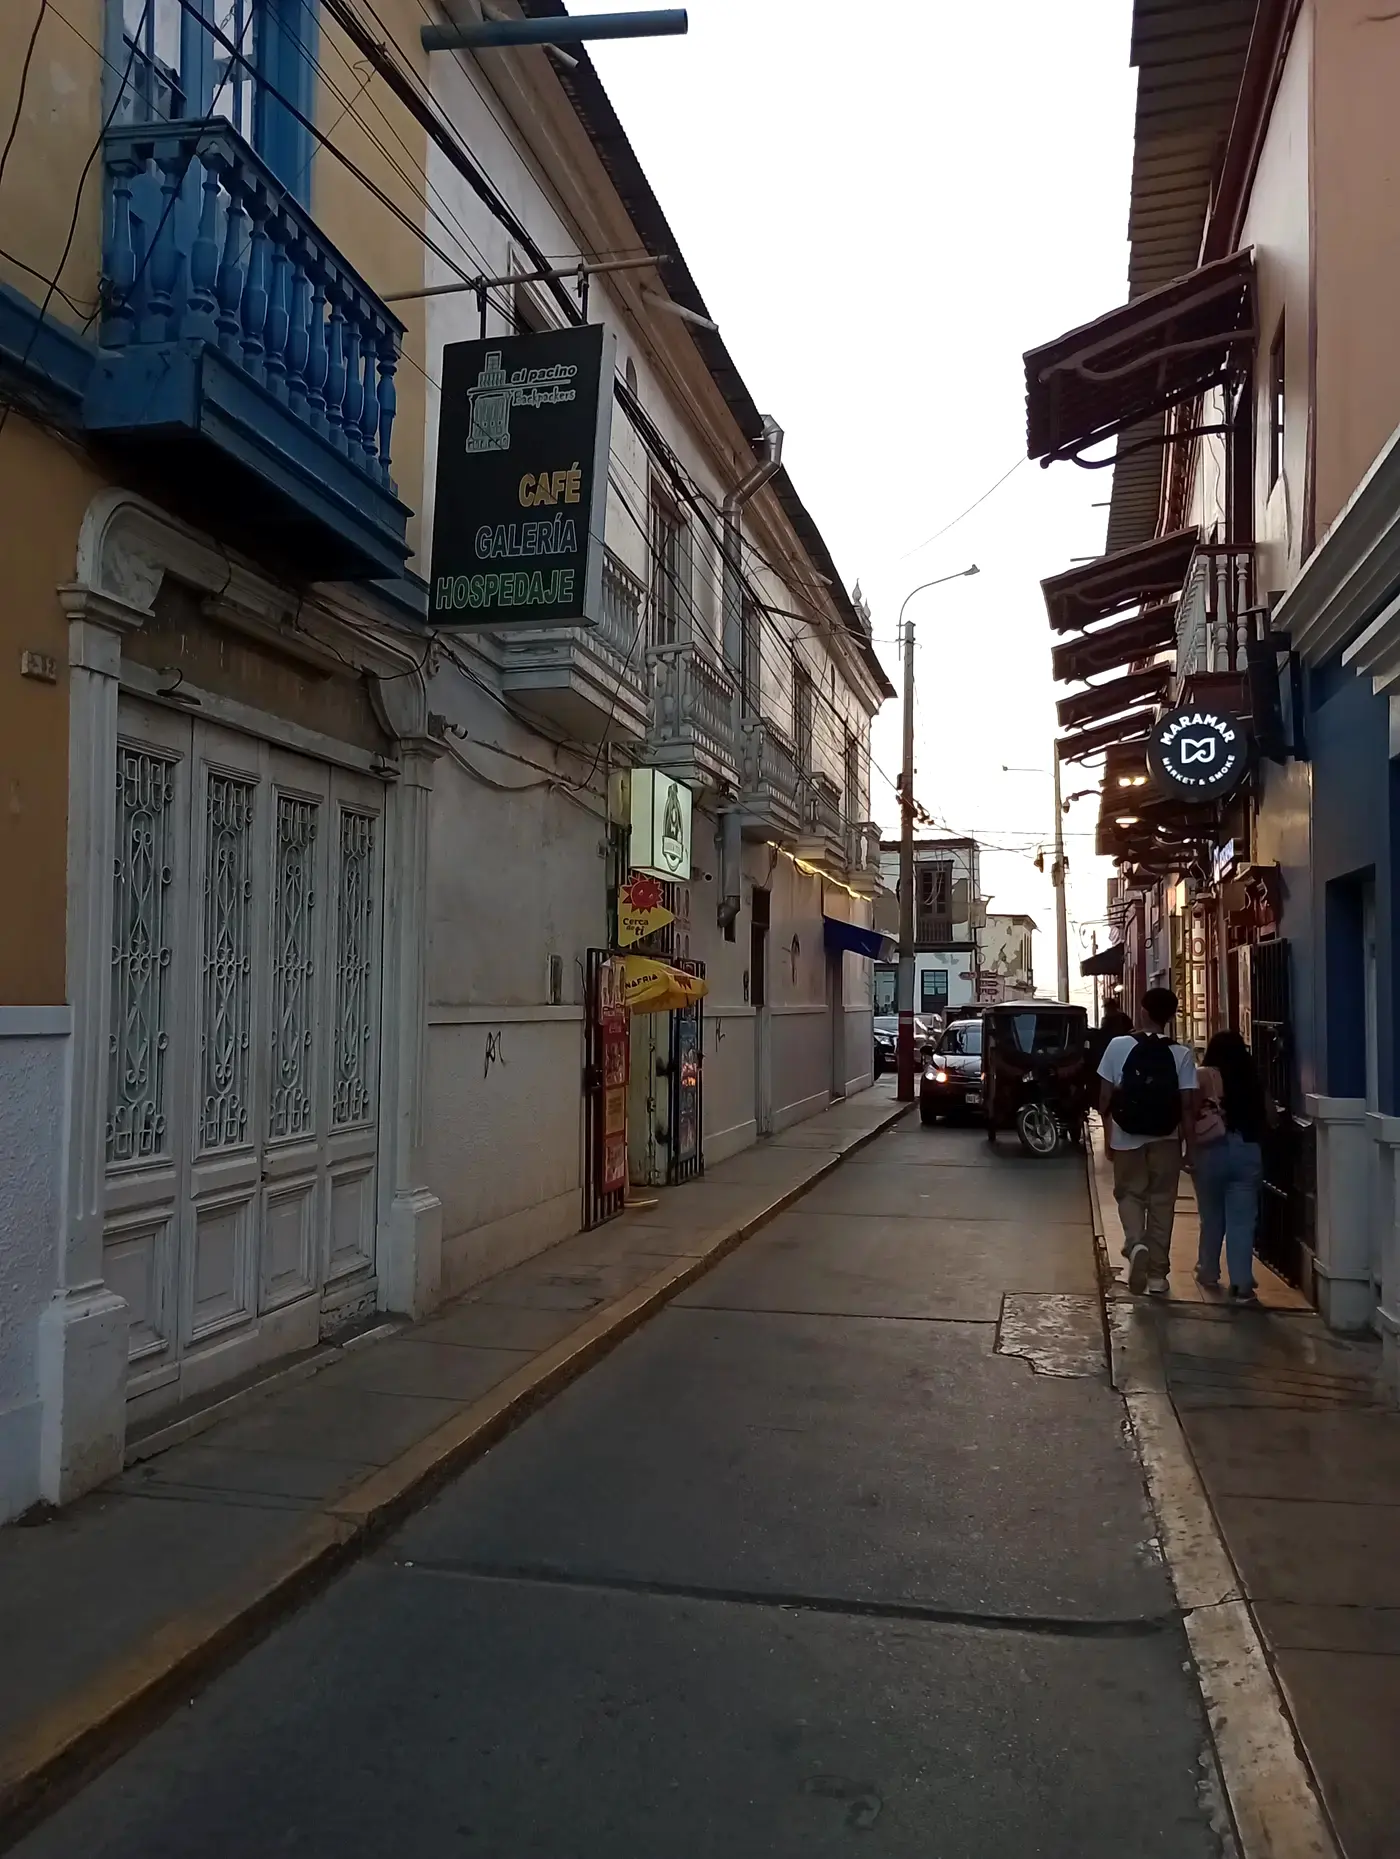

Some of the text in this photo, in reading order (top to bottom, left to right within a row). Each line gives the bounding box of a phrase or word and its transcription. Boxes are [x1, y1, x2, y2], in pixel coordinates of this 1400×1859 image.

[511, 364, 577, 385] al pacino
[519, 462, 582, 508] CAFÉ
[475, 512, 577, 559] GALERÍA
[436, 569, 574, 609] HOSPEDAJE
[1160, 713, 1235, 746] MARAMAR
[1162, 754, 1236, 786] MARKET & SMOKE
[622, 917, 649, 926] Cerca
[635, 926, 644, 936] ti
[1192, 909, 1206, 1041] HOTEL
